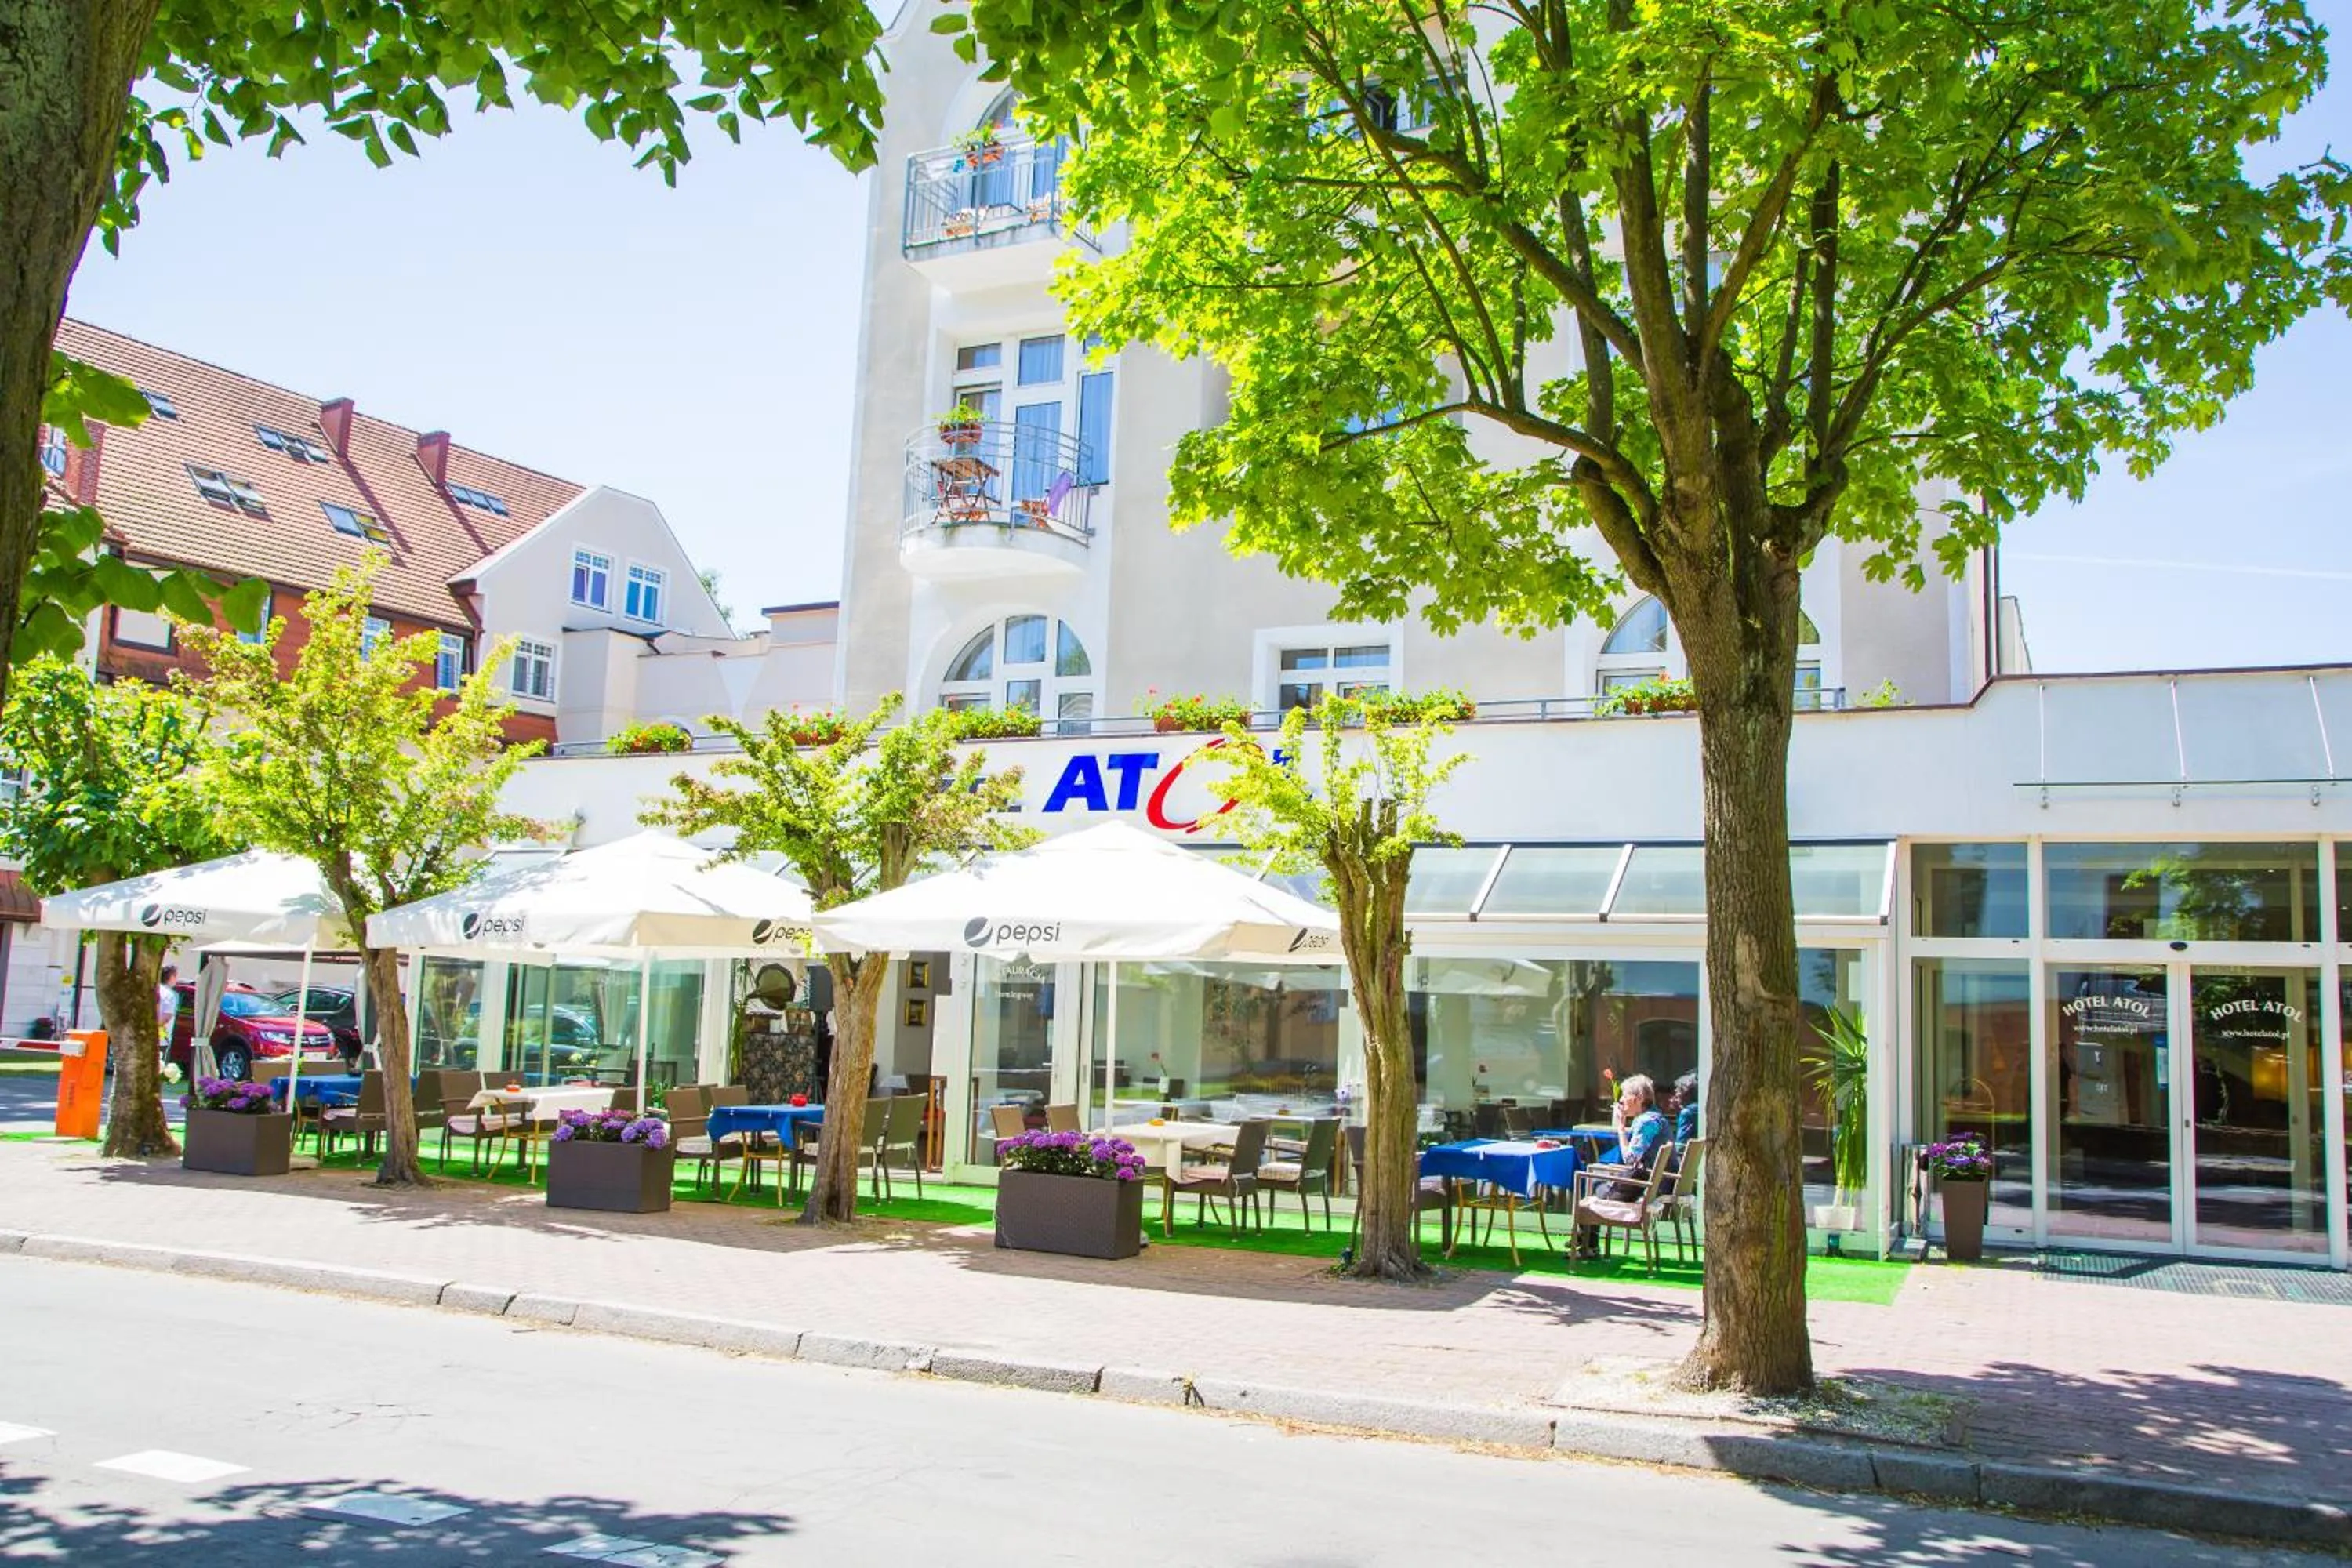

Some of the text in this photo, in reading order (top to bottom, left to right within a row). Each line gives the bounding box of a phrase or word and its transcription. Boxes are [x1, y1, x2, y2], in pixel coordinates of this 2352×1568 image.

[1042, 737, 1311, 834] ATO
[163, 909, 209, 927] pepsi
[482, 915, 527, 937] pepsi
[772, 926, 813, 946] peps
[996, 921, 1061, 946] pepsi
[2062, 996, 2151, 1018] HOTEL ATOL
[2209, 1000, 2303, 1023] HOTEL ATOL
